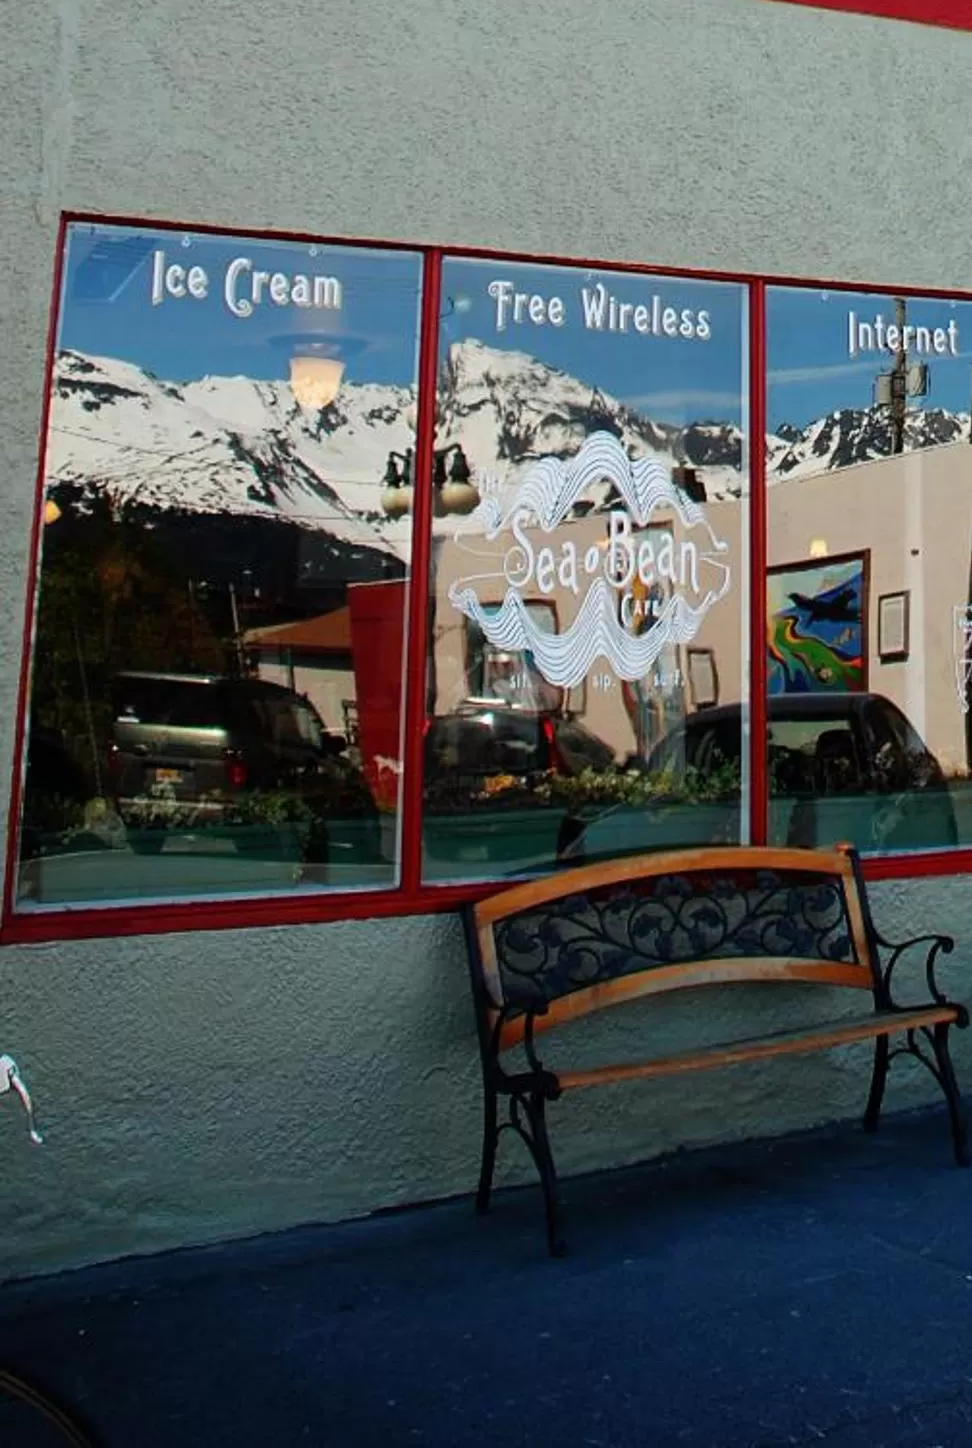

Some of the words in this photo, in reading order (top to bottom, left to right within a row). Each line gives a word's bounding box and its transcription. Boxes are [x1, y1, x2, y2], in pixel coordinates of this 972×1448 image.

[151, 250, 208, 305] Ice
[224, 257, 341, 318] Cream
[488, 280, 564, 331] Free
[582, 283, 712, 340] Wireless
[848, 311, 958, 356] Internet
[502, 509, 580, 596] Sea
[604, 509, 700, 595] Bean
